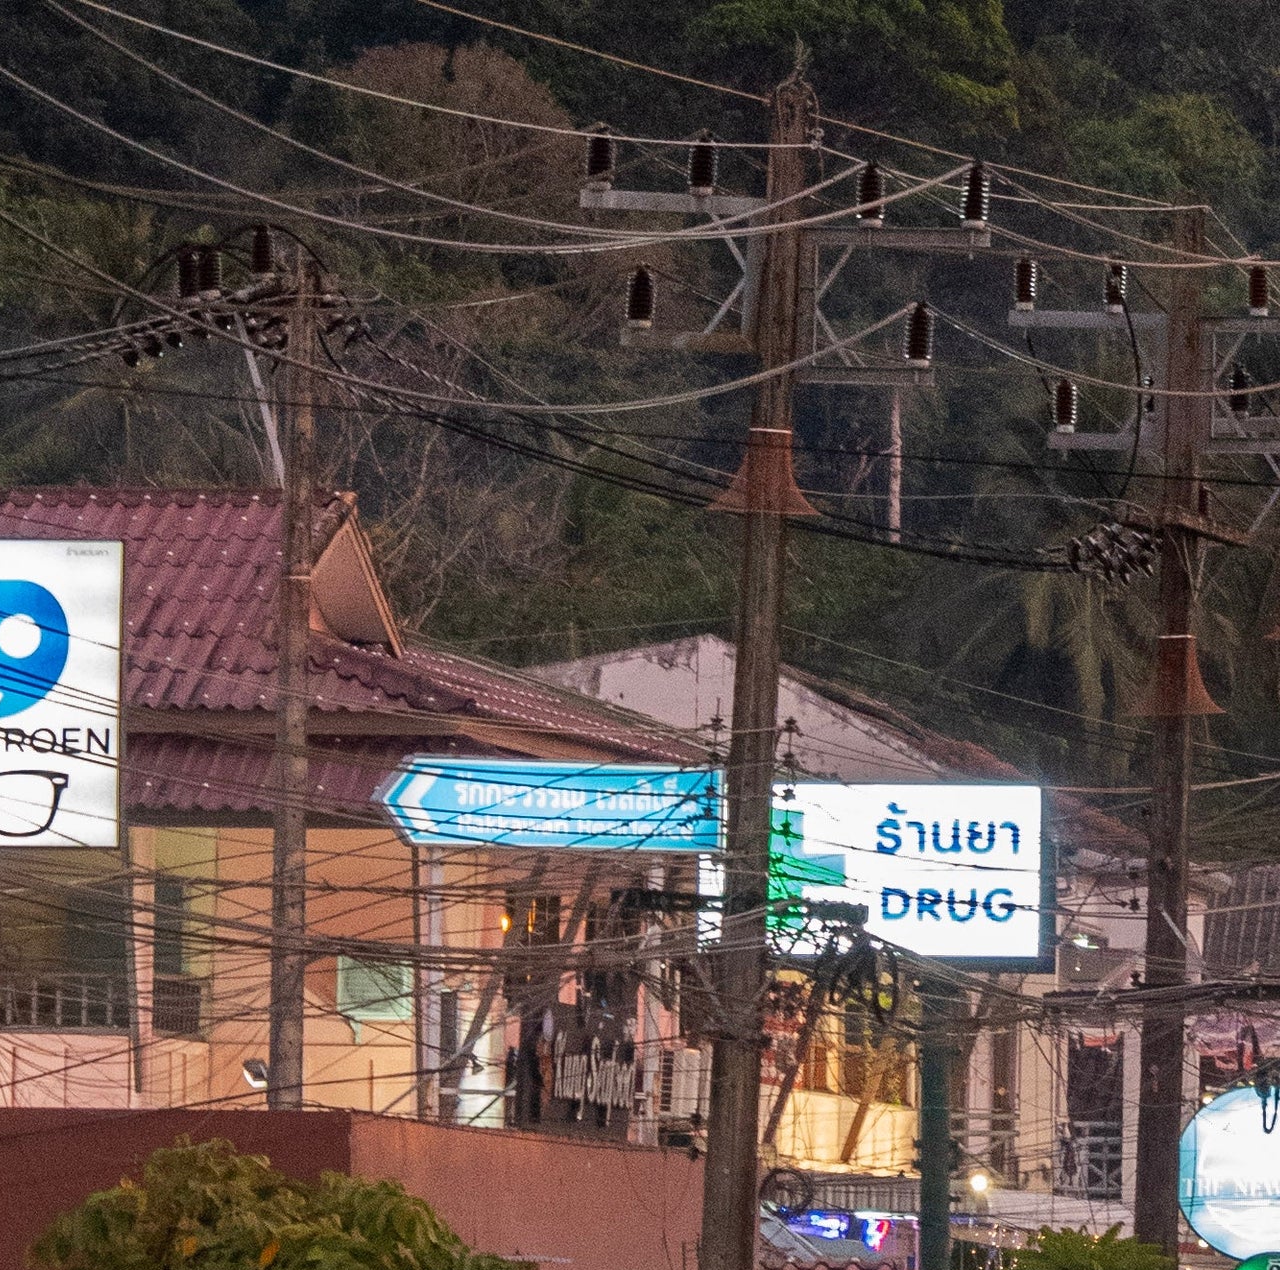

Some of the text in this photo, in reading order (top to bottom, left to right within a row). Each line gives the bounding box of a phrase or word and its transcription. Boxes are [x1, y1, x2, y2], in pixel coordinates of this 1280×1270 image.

[876, 801, 1020, 856] ร้านยา
[881, 886, 1015, 923] DRUG
